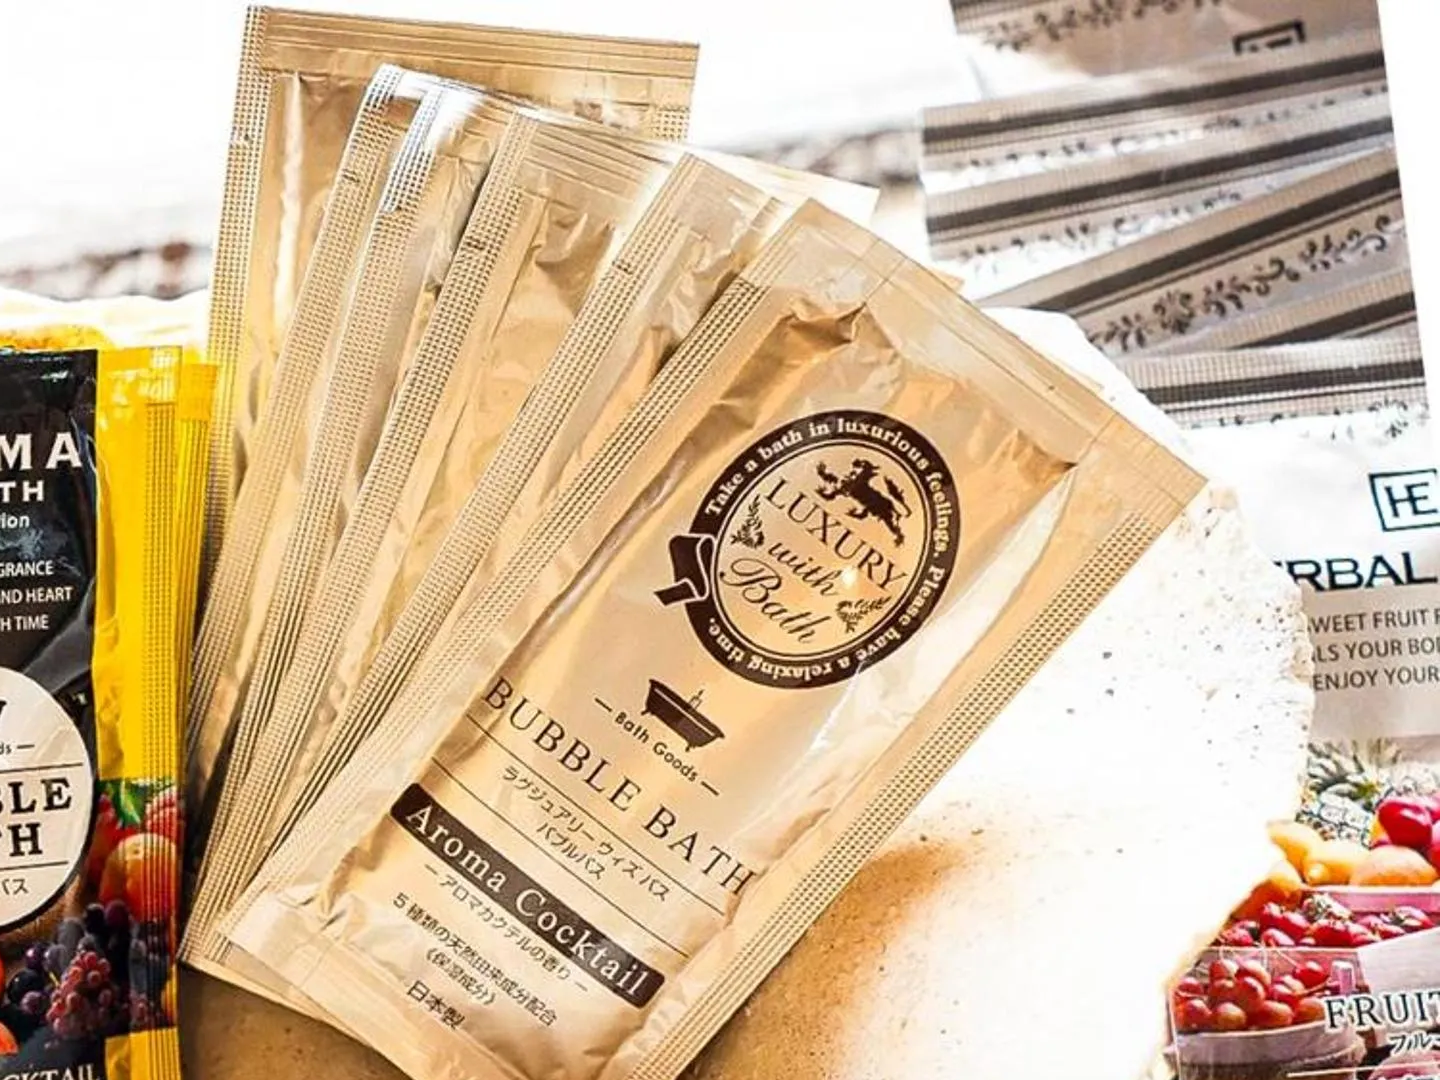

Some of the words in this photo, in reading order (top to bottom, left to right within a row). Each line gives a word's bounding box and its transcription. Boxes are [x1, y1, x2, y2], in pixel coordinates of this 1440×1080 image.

[757, 429, 803, 460] bath
[810, 422, 832, 438] in
[837, 418, 928, 473] luxurious
[745, 460, 758, 474] a
[705, 471, 744, 518] Take
[765, 476, 907, 590] LUXURY
[768, 542, 840, 598] with
[1272, 551, 1440, 592] RBAL
[25, 585, 74, 604] HEART
[719, 557, 834, 645] Bath
[899, 565, 946, 627] Please
[16, 613, 49, 632] TIME
[1307, 612, 1368, 634] WEET
[1373, 607, 1429, 629] FRUIT
[856, 627, 902, 661] have
[1311, 644, 1340, 663] LS
[1344, 639, 1403, 660] YOUR
[747, 655, 833, 682] relaxing
[1312, 669, 1379, 692] ENJOY
[1384, 665, 1440, 687] YOUR
[615, 711, 650, 745] Bath
[653, 741, 698, 783] Goods
[484, 677, 642, 812] BUBBLE
[642, 805, 759, 895] BATH
[536, 823, 605, 880] バブルバス
[405, 802, 506, 894] Aroma
[515, 889, 651, 996] Cocktail
[406, 980, 466, 1030] 日本製
